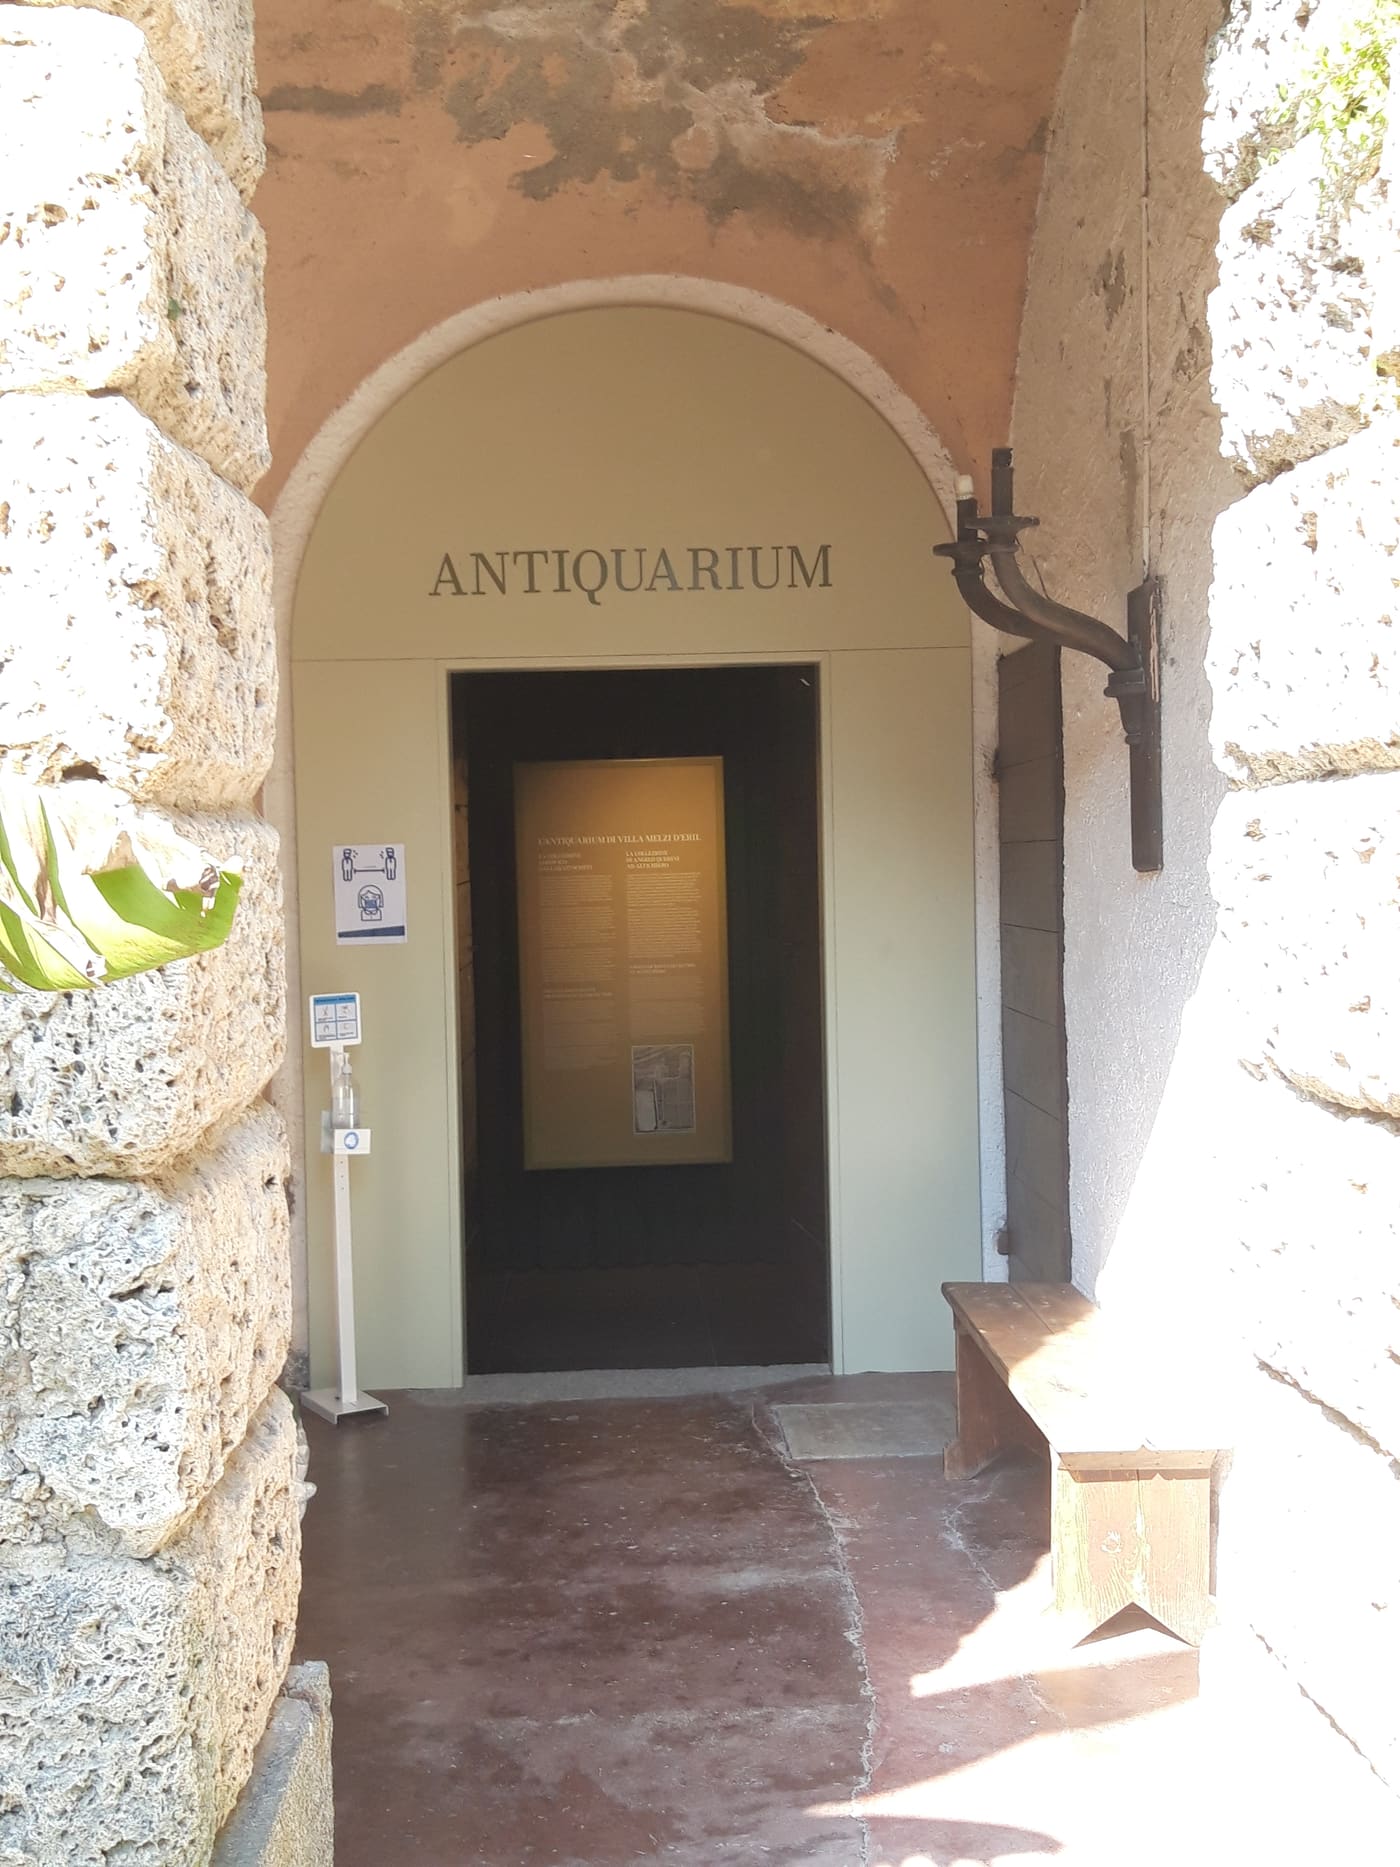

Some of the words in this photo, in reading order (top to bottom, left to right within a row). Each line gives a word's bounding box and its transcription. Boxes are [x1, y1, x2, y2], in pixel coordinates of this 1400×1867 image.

[429, 545, 832, 605] ANTIQUARIUM
[607, 835, 616, 844] DI
[617, 834, 644, 844] VILLA
[645, 833, 671, 843] MELZI
